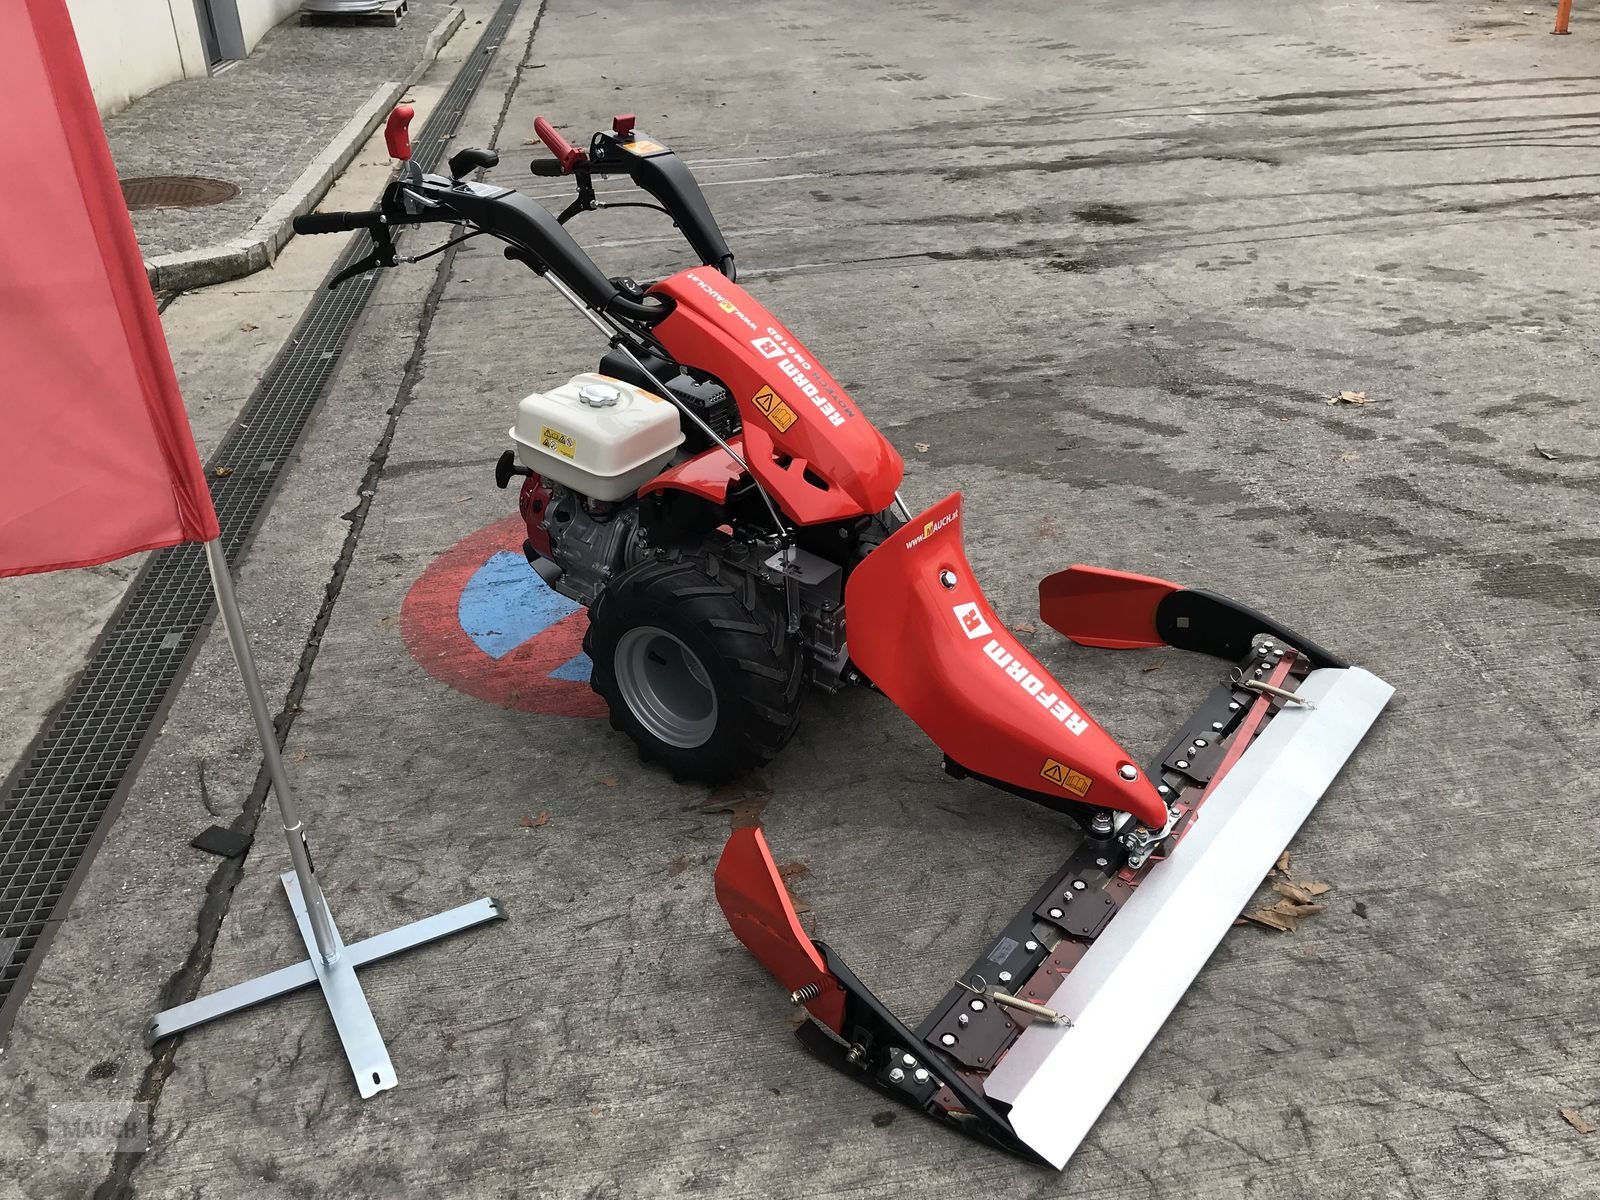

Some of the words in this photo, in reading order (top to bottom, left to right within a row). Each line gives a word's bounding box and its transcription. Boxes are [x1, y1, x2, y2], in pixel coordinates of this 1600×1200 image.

[686, 273, 758, 331] www.MAUCH.at
[777, 359, 846, 427] REFORM
[812, 372, 855, 418] MOTECH
[905, 509, 959, 549] www.MAUCH.at
[983, 639, 1089, 736] REFORM
